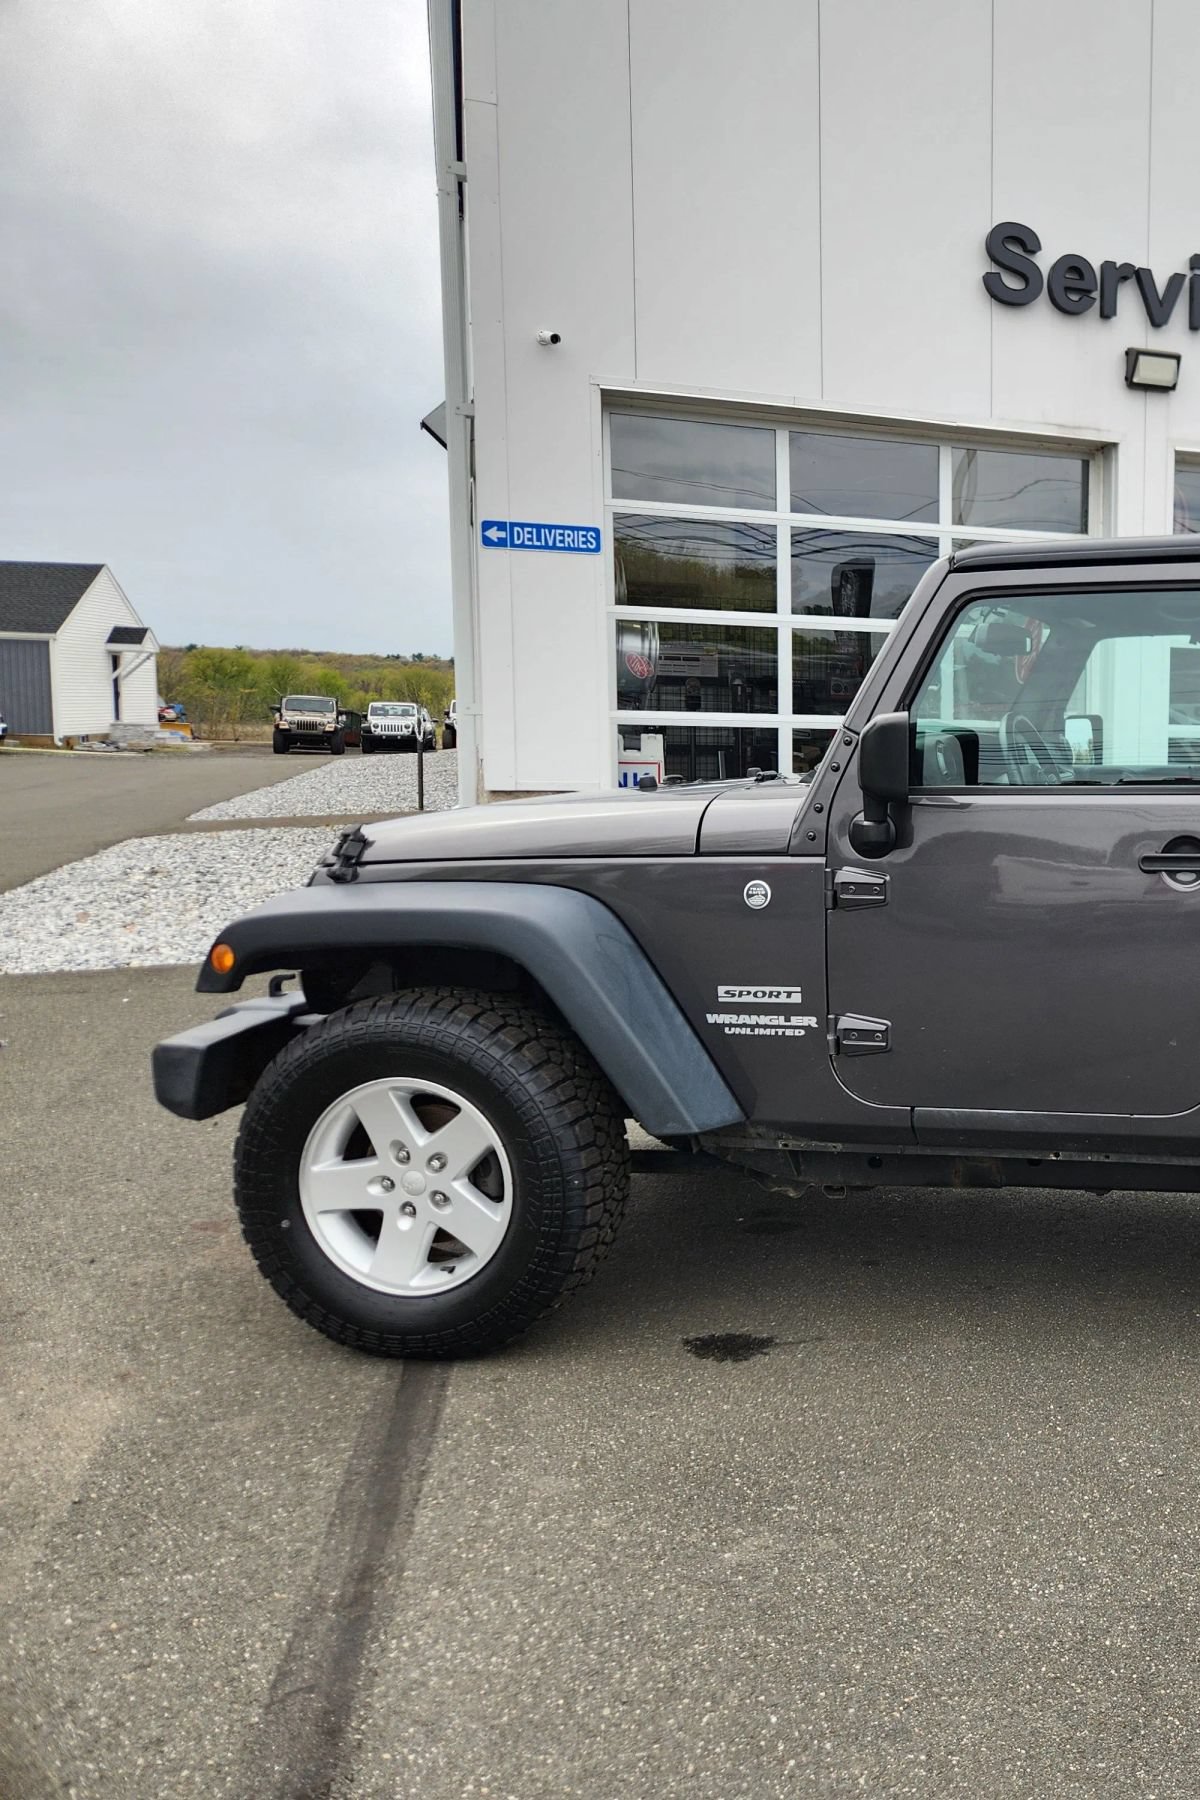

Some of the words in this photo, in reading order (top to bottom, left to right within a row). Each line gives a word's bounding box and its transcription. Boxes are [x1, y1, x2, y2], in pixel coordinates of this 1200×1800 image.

[513, 526, 597, 549] DELIVERIES
[721, 989, 797, 999] SPORT
[705, 1013, 819, 1028] WRANGLER
[724, 1026, 806, 1037] UNLIMITED
